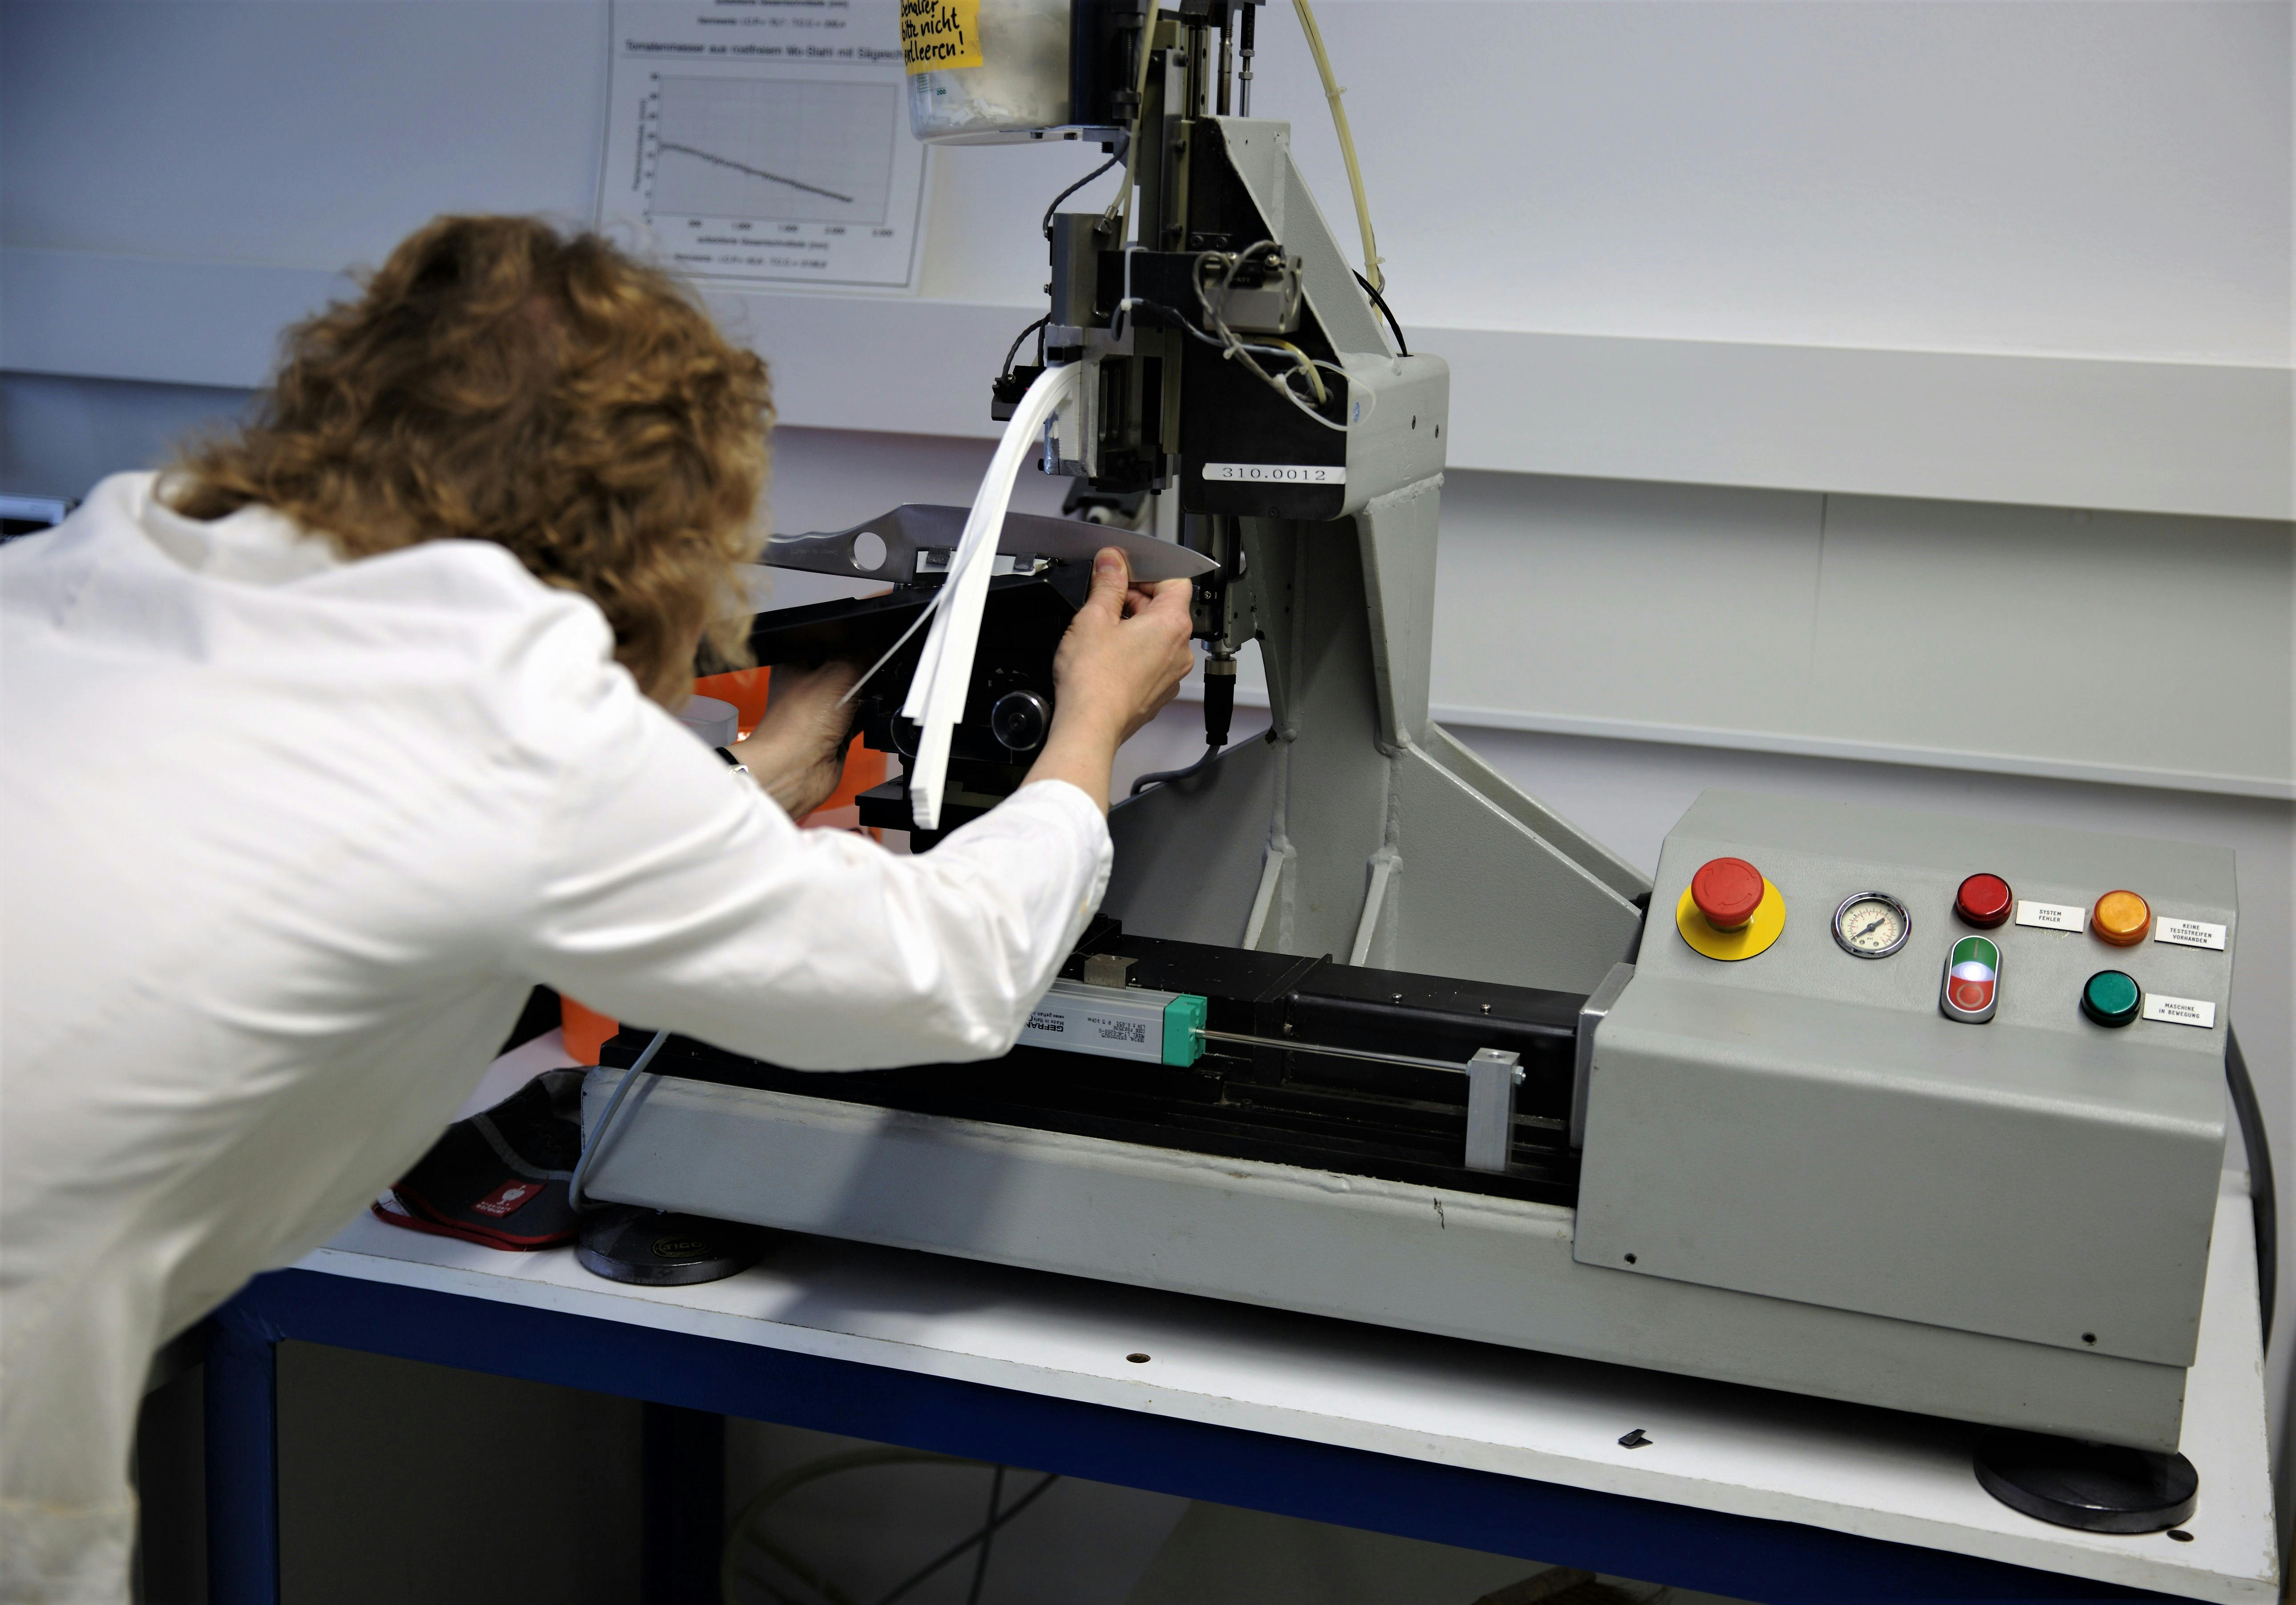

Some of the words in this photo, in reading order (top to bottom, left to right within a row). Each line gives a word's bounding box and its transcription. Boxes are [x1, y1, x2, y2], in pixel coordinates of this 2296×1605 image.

[902, 20, 918, 41] bitte
[921, 6, 960, 36] nicht
[1223, 467, 1326, 481] 310.0012
[2170, 928, 2212, 938] TESTSTREIFEN
[2173, 934, 2207, 944] VORHANDEN
[2165, 1003, 2195, 1011] MASCHINE
[2168, 1010, 2199, 1018] BEWEGUNG
